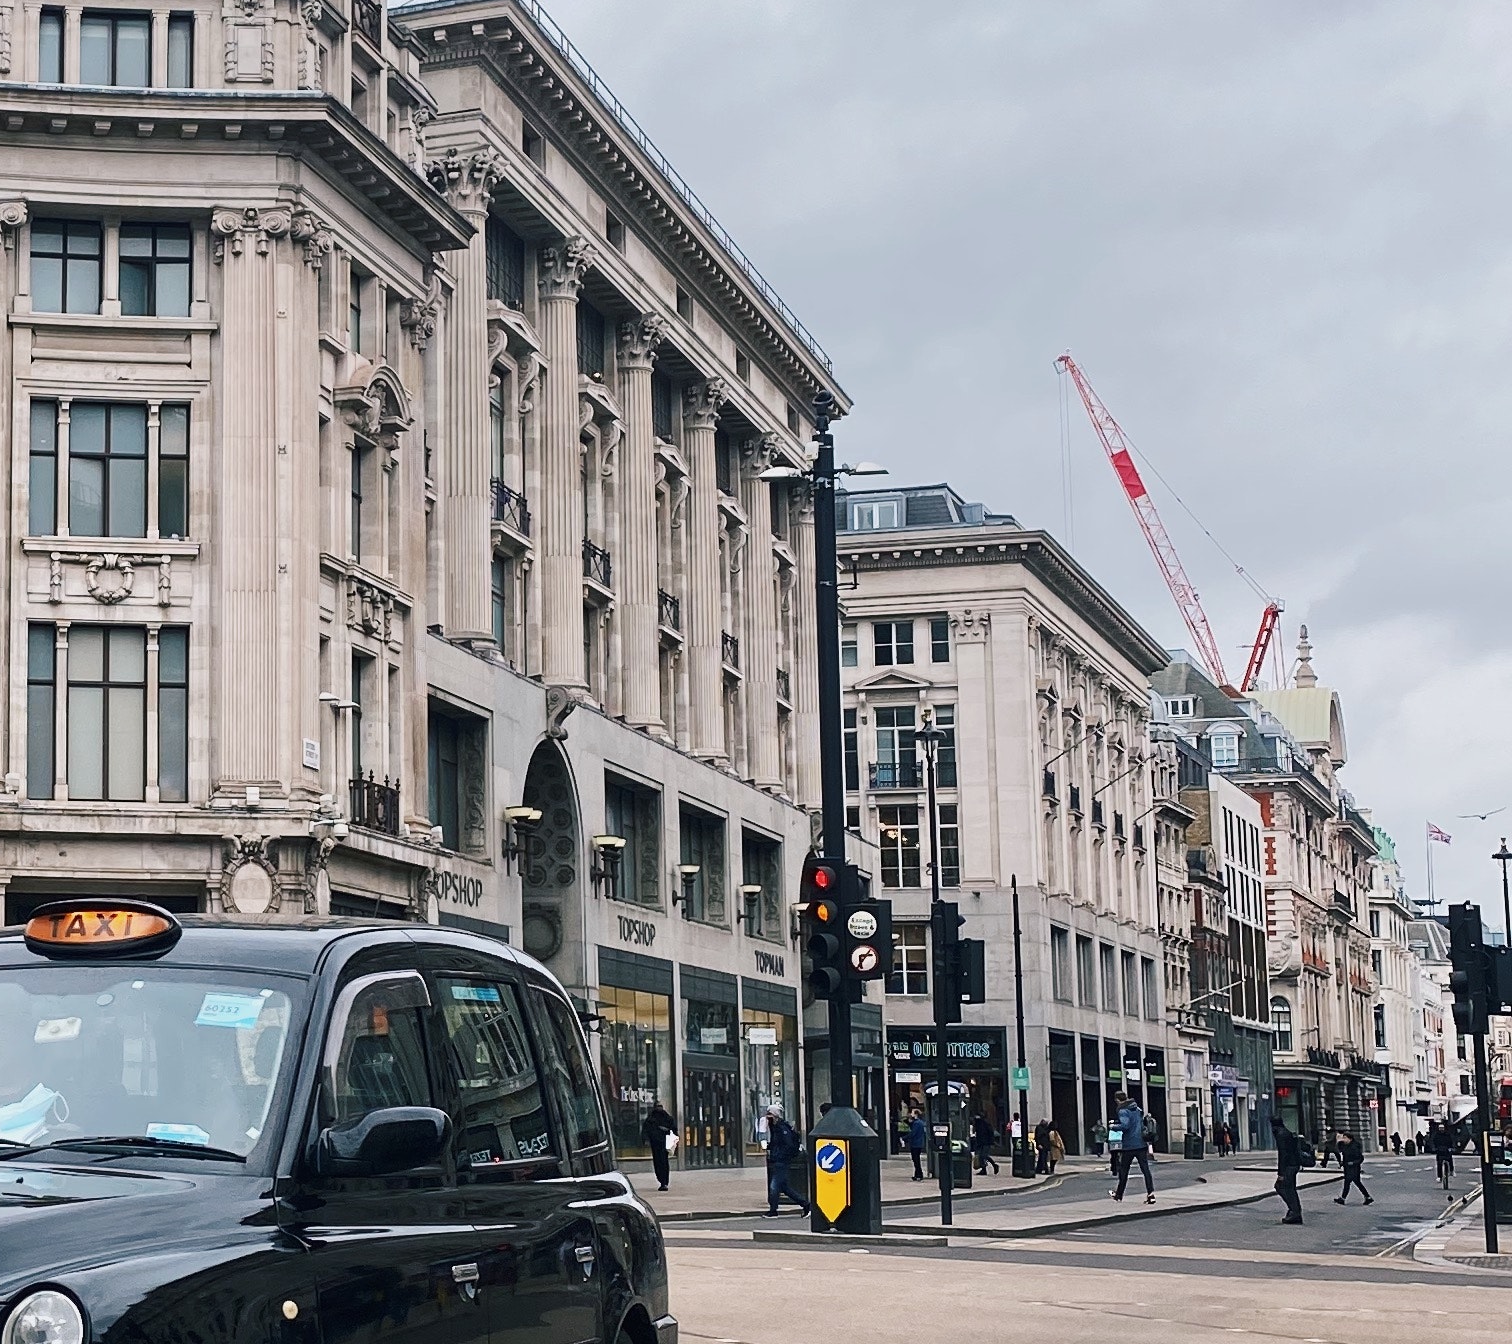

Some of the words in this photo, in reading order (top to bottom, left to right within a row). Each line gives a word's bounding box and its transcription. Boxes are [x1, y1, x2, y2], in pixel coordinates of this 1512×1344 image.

[436, 870, 483, 908] OPSHOP
[48, 912, 134, 938] TAXI
[617, 915, 656, 947] TOPSHOP
[754, 950, 785, 978] TOPMAN
[913, 1041, 990, 1058] OUTITTERS
